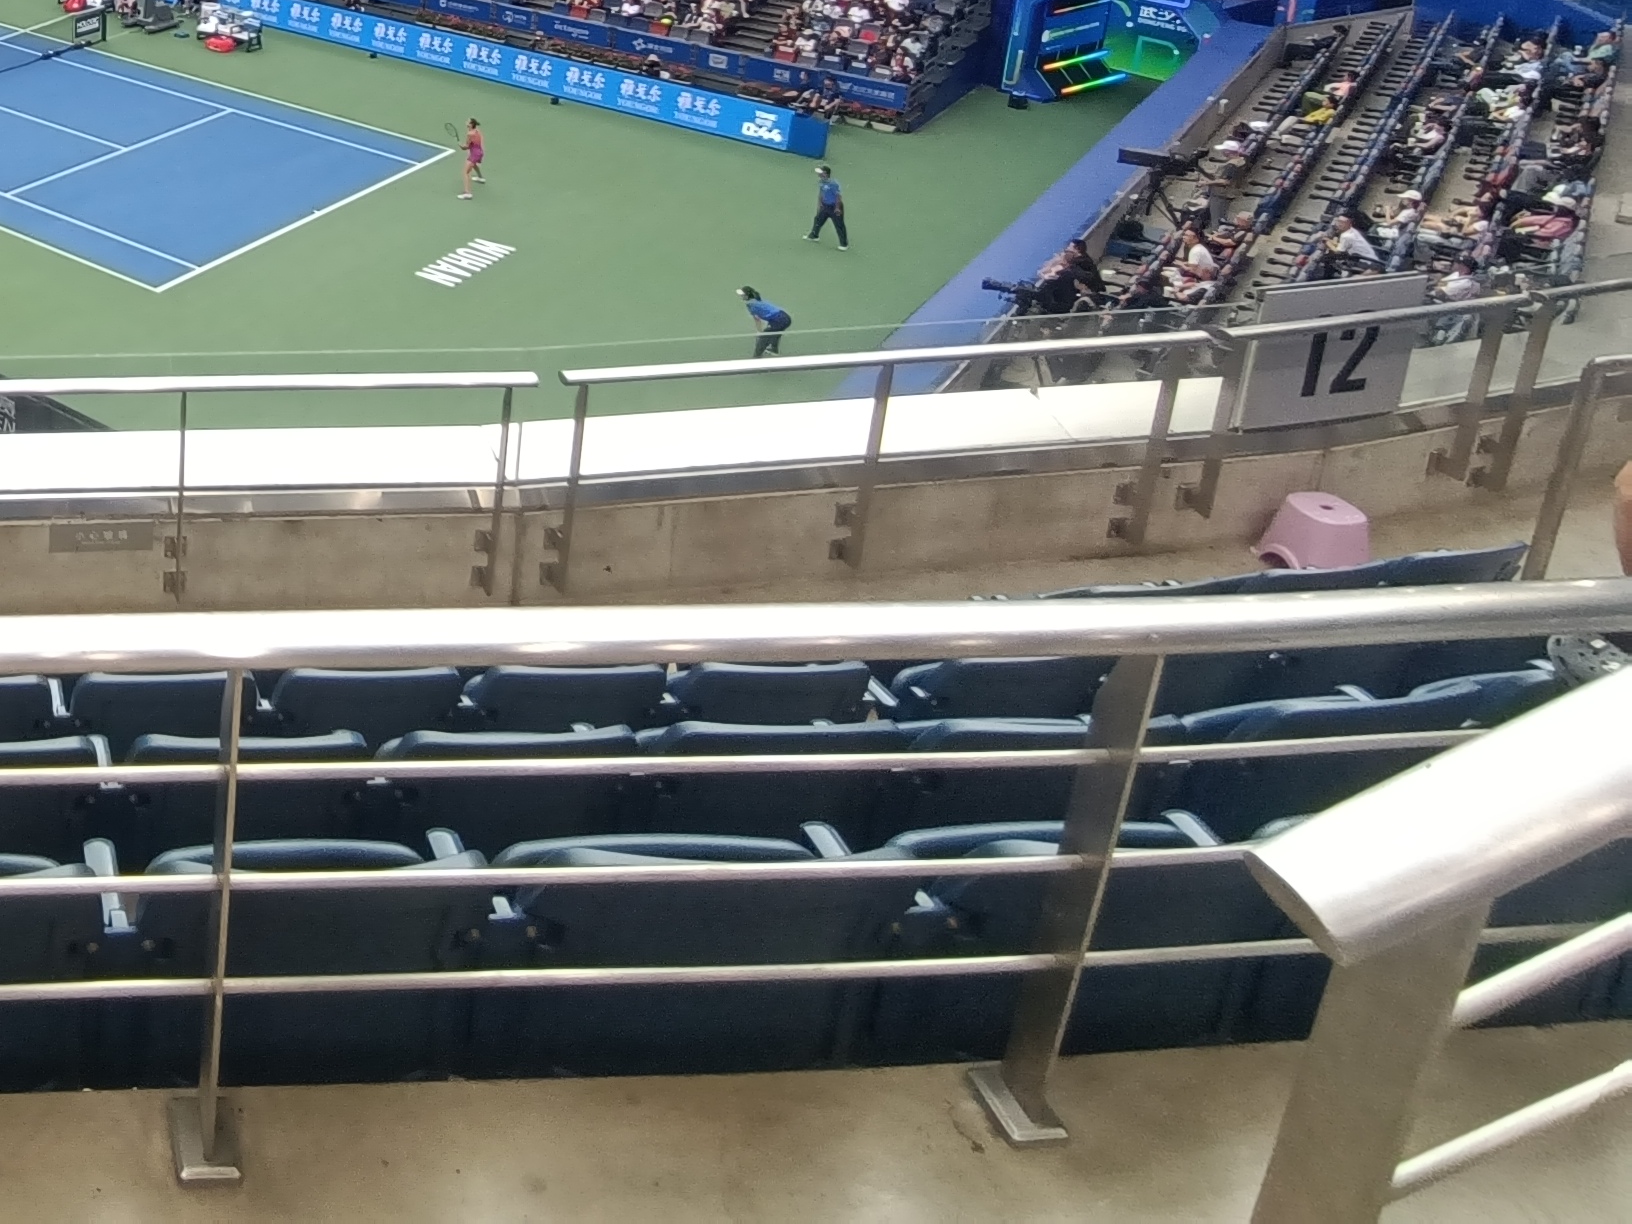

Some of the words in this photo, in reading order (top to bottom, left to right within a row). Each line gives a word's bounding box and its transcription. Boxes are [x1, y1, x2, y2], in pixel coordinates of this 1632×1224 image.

[512, 73, 548, 89] YOUNGOR
[563, 85, 602, 101] YOUNGOR
[742, 122, 782, 143] 0:44
[415, 238, 517, 288] WUHAN
[1300, 311, 1381, 397] 12
